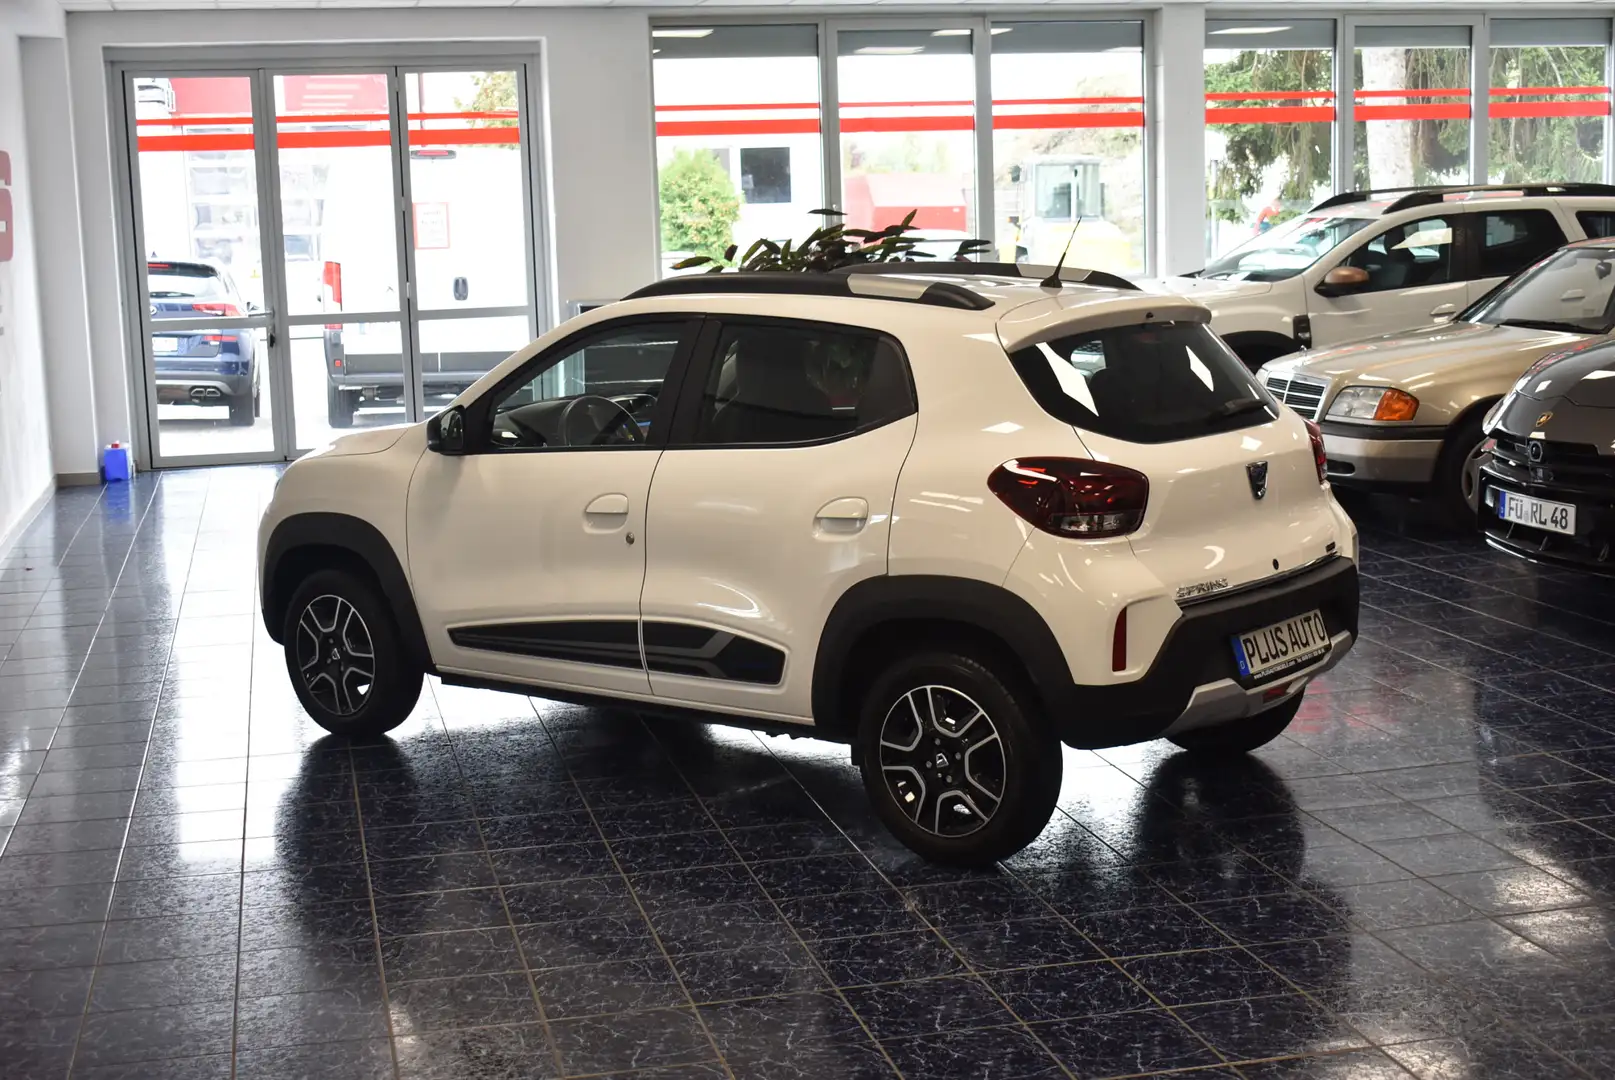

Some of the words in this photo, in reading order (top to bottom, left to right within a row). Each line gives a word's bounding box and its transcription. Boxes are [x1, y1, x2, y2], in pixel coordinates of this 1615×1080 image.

[1508, 496, 1523, 520] FÜ
[1530, 501, 1547, 526] RL
[1550, 506, 1568, 530] 48
[1242, 626, 1289, 668] PLUS
[1286, 612, 1326, 653] AUTO
